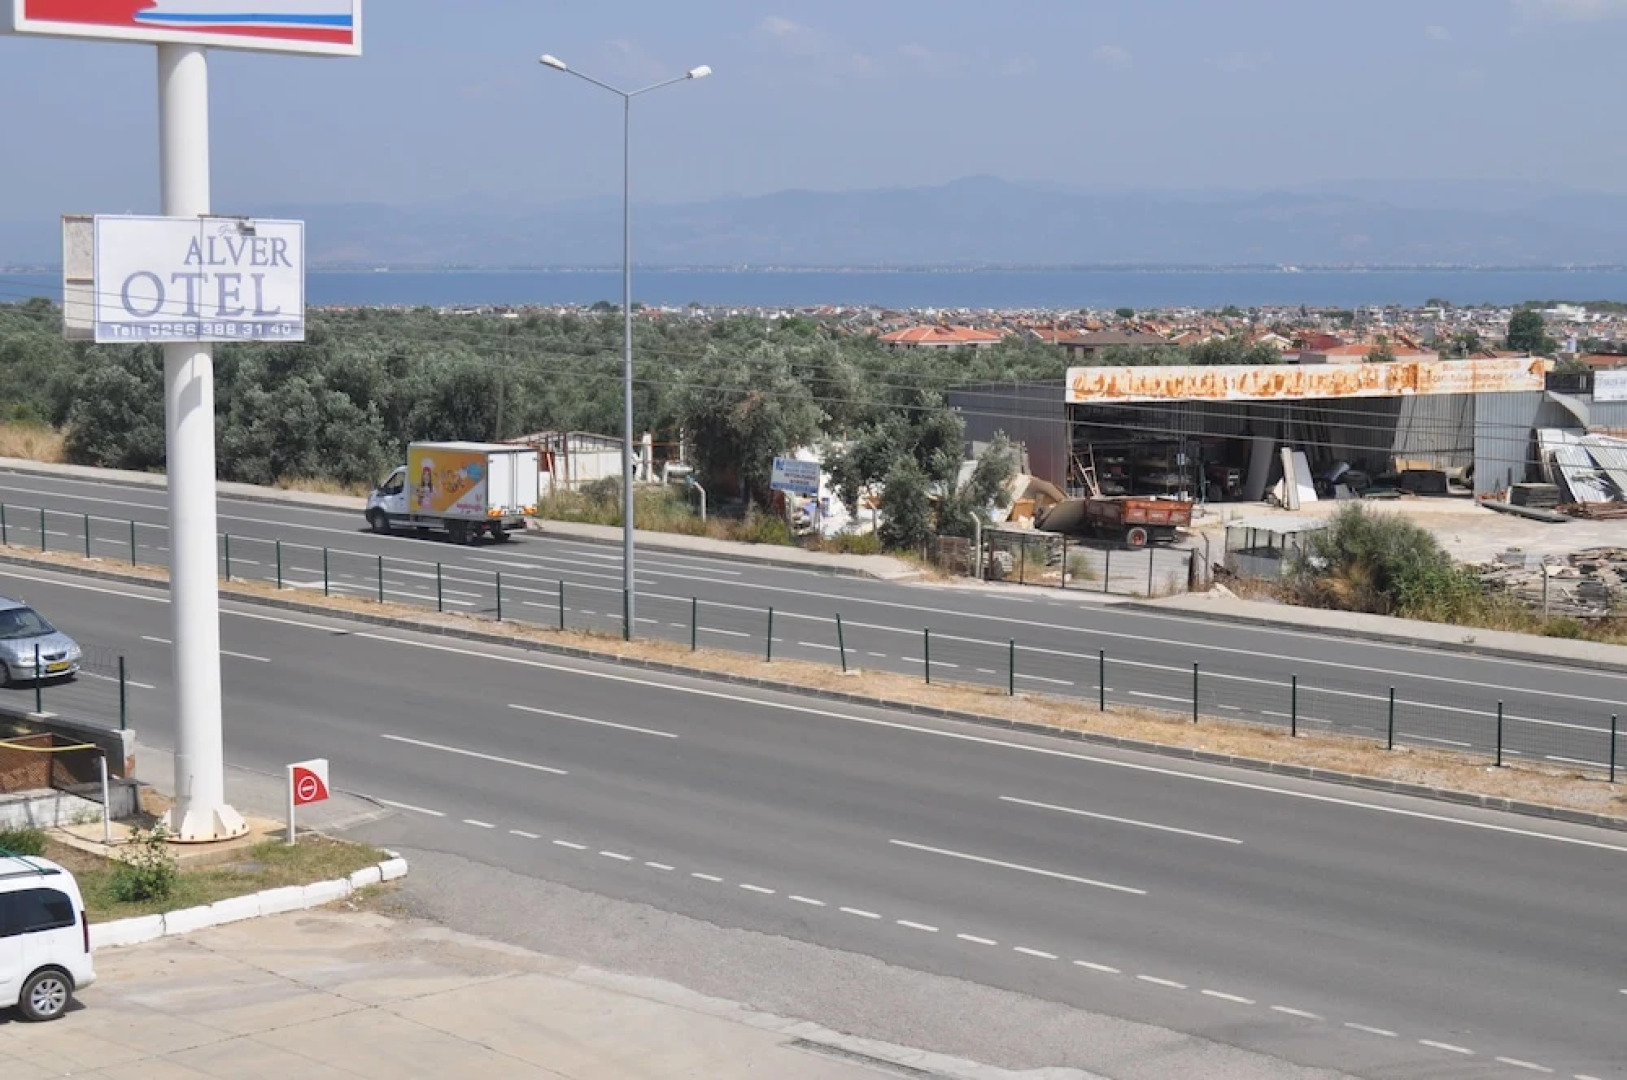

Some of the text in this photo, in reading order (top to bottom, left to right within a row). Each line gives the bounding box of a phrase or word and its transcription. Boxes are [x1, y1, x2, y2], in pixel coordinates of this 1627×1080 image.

[183, 235, 293, 267] ALVER
[121, 271, 281, 318] OTEL
[111, 324, 143, 337] Tel:
[202, 323, 237, 336] 388
[243, 323, 263, 336] 31
[270, 323, 292, 336] 40
